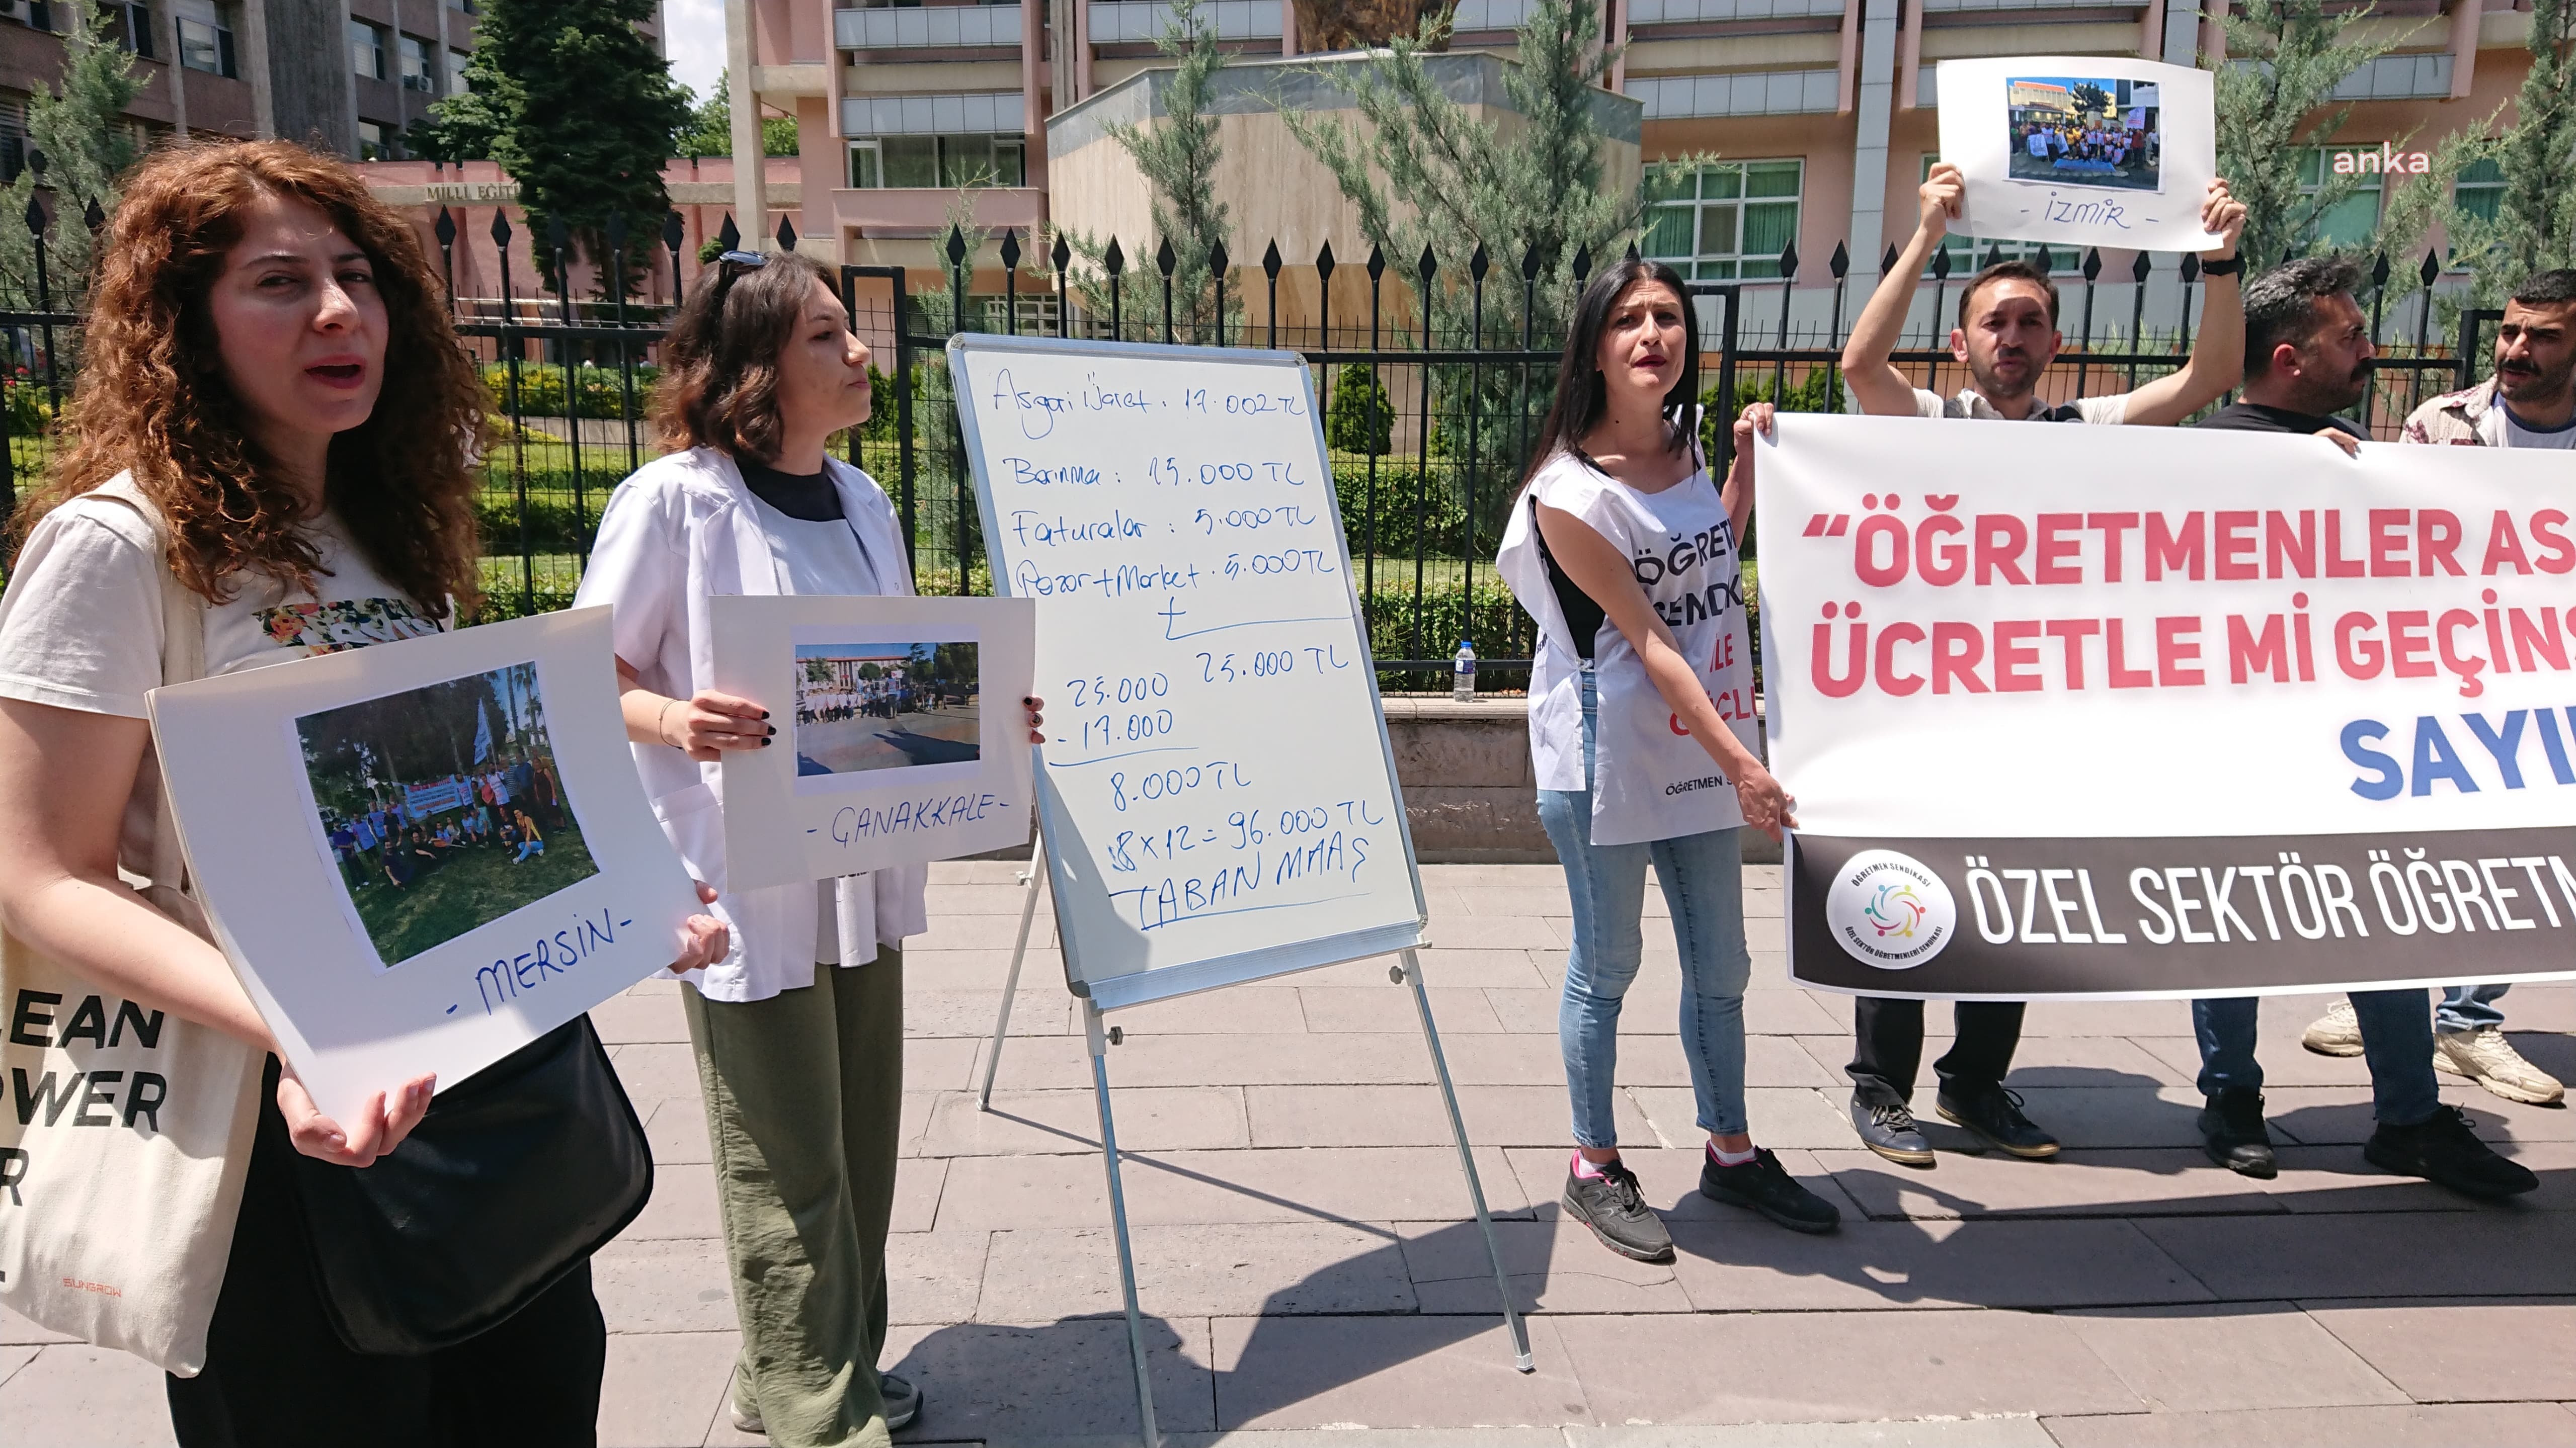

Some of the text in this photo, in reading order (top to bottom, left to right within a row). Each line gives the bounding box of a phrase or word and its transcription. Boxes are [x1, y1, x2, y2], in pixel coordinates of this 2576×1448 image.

[2044, 191, 2131, 229] İZMİR
[1262, 463, 1305, 485] TL
[1011, 509, 1148, 547] Faturalar
[1275, 505, 1317, 526] TL
[1811, 588, 2576, 698] ÜCRETLE Mİ GEÇİN
[1196, 644, 1349, 683] 25.000 TL
[1067, 672, 1168, 707] 25.000
[2339, 706, 2576, 801] SAYI
[1110, 761, 1252, 812] 8.000 TL
[1665, 775, 1723, 796] ÖĞRETMEN
[1336, 799, 1384, 825] TL
[1108, 850, 1261, 930] TABAN
[1850, 863, 1931, 888] ÖĞRETMEN SENDİKASI
[1965, 856, 2128, 944] ÖZEL
[2129, 852, 2370, 945] SEKTÖR
[474, 908, 614, 1015] MERSİN
[1845, 925, 1944, 960] ÖZEL SEKTÖR ÖĞRETMENLERİ SENDİKASI
[0, 989, 165, 1049] EAN
[0, 1067, 167, 1133] WER
[62, 1278, 121, 1298] SUNGROW
